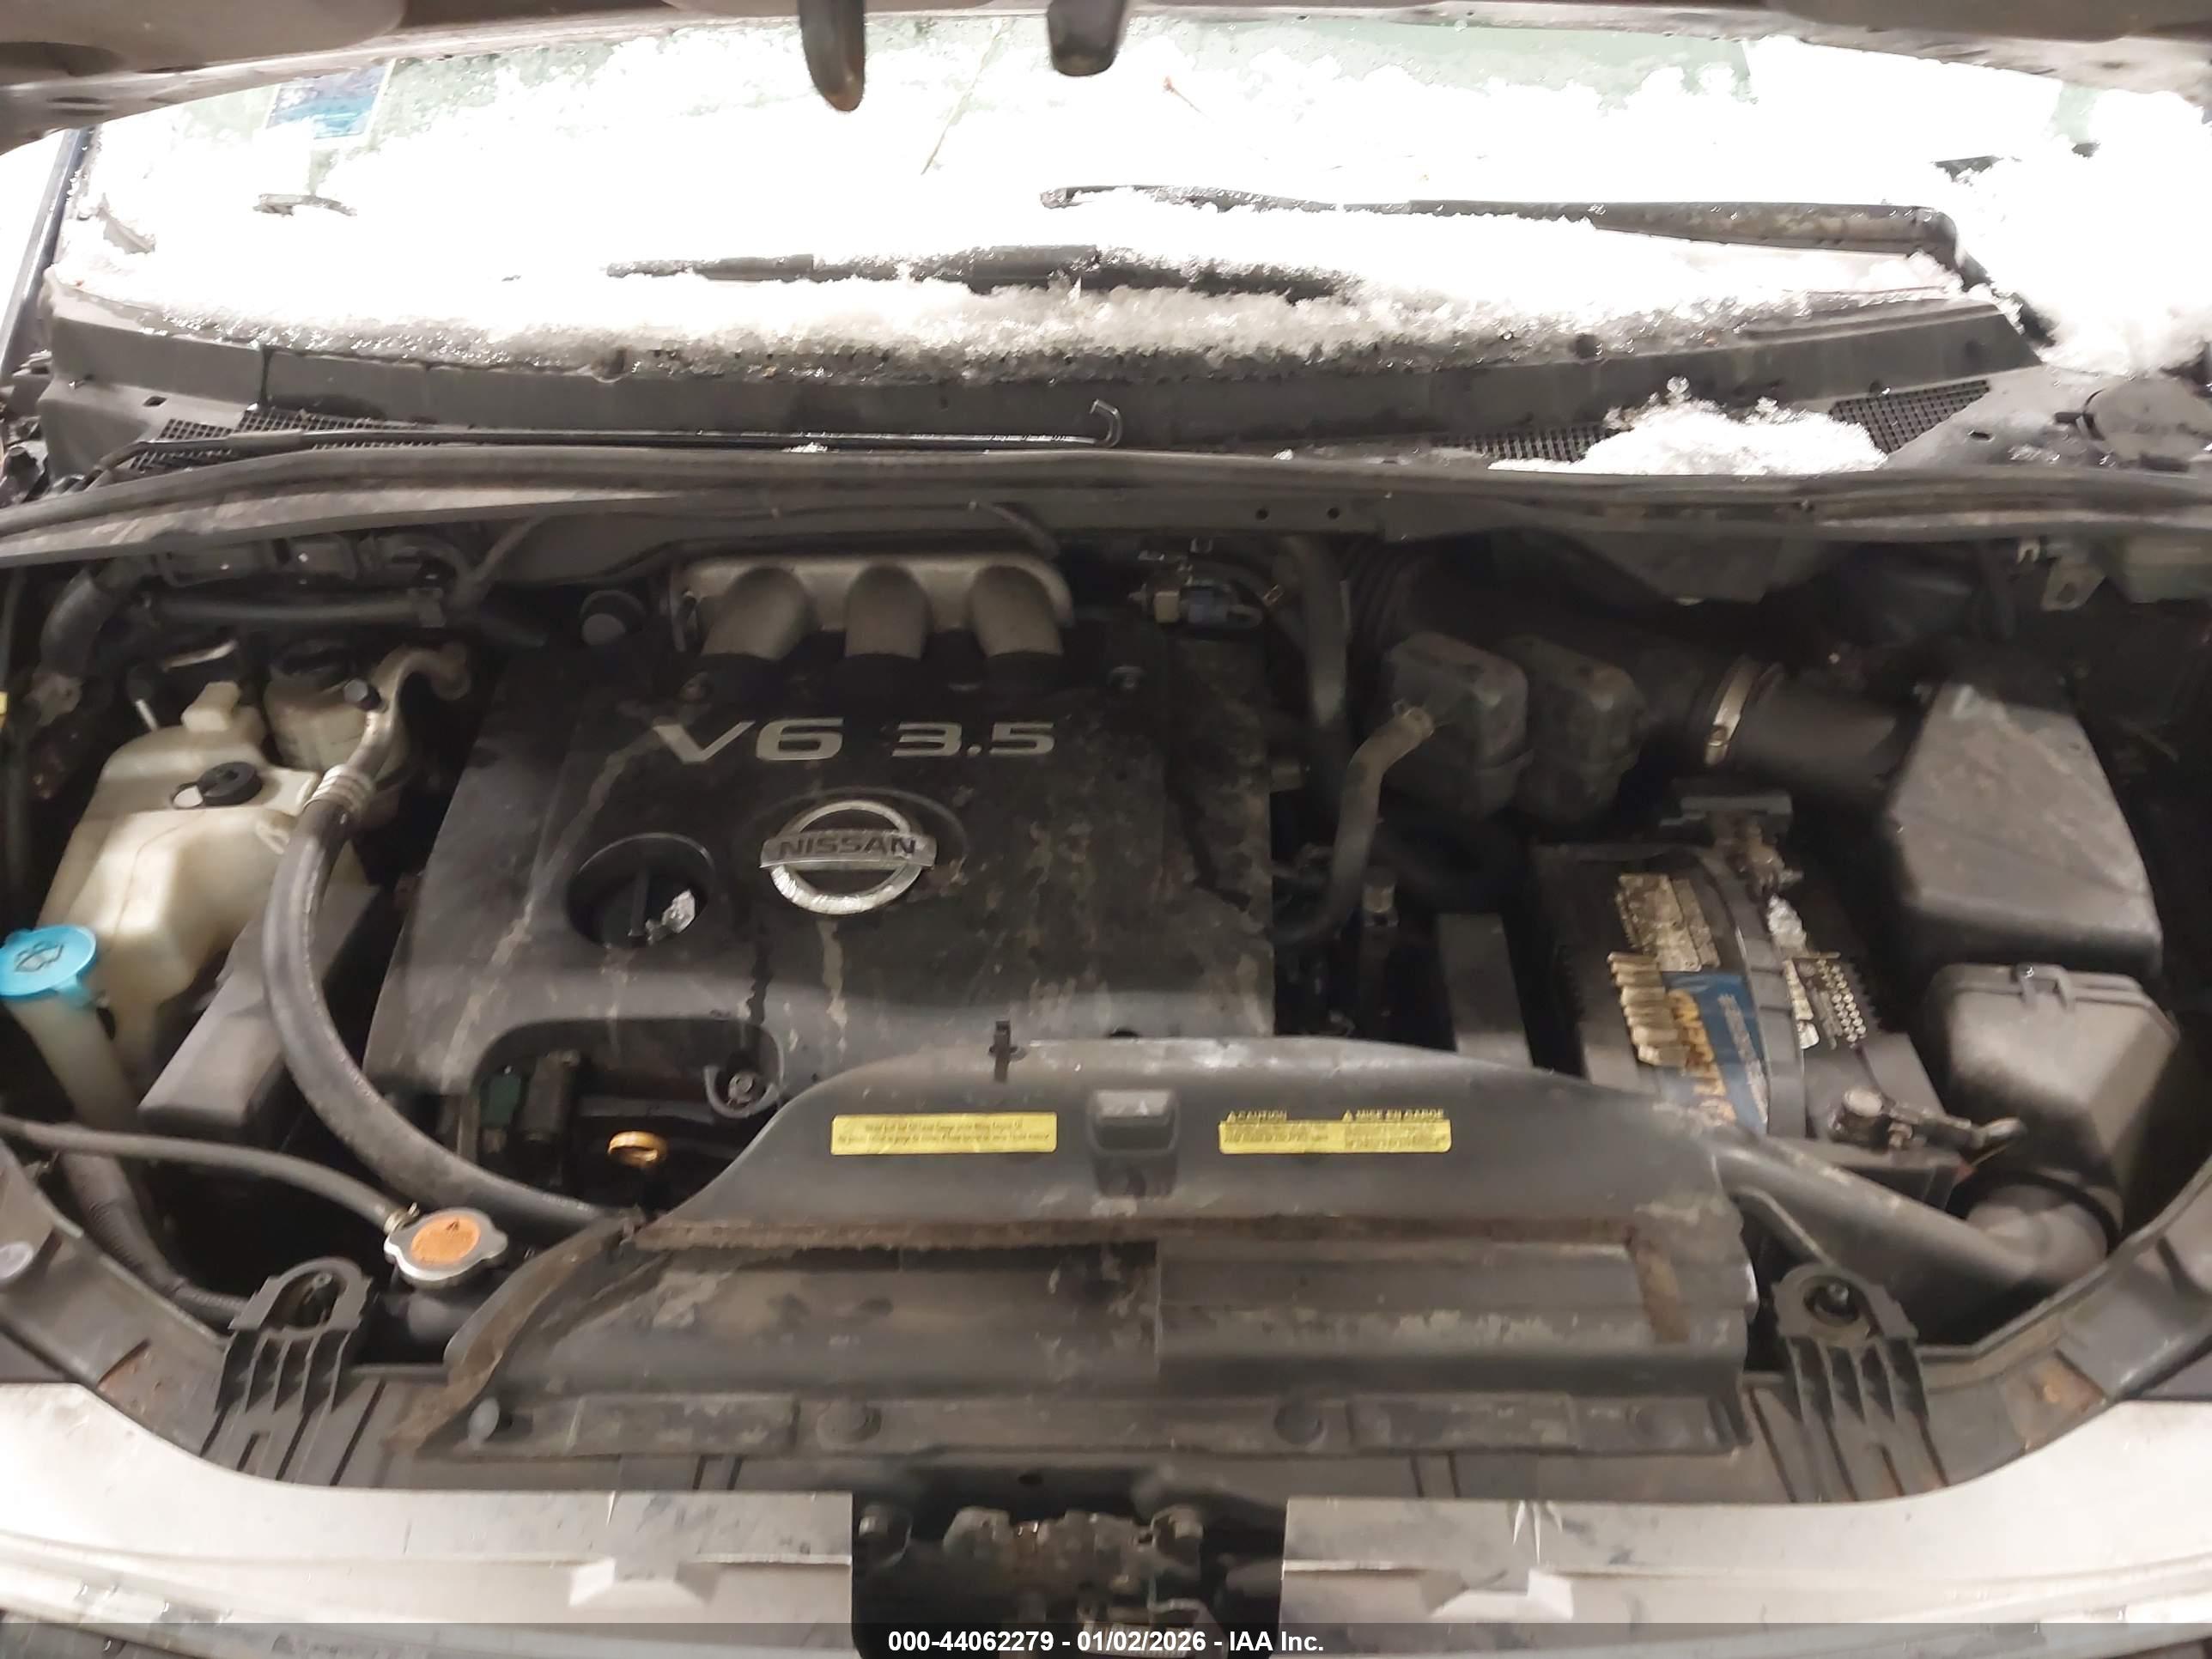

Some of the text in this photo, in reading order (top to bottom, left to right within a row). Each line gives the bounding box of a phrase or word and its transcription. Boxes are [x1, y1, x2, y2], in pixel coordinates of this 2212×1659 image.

[653, 717, 1054, 763] V6 3.5
[778, 836, 916, 857] NISSAN
